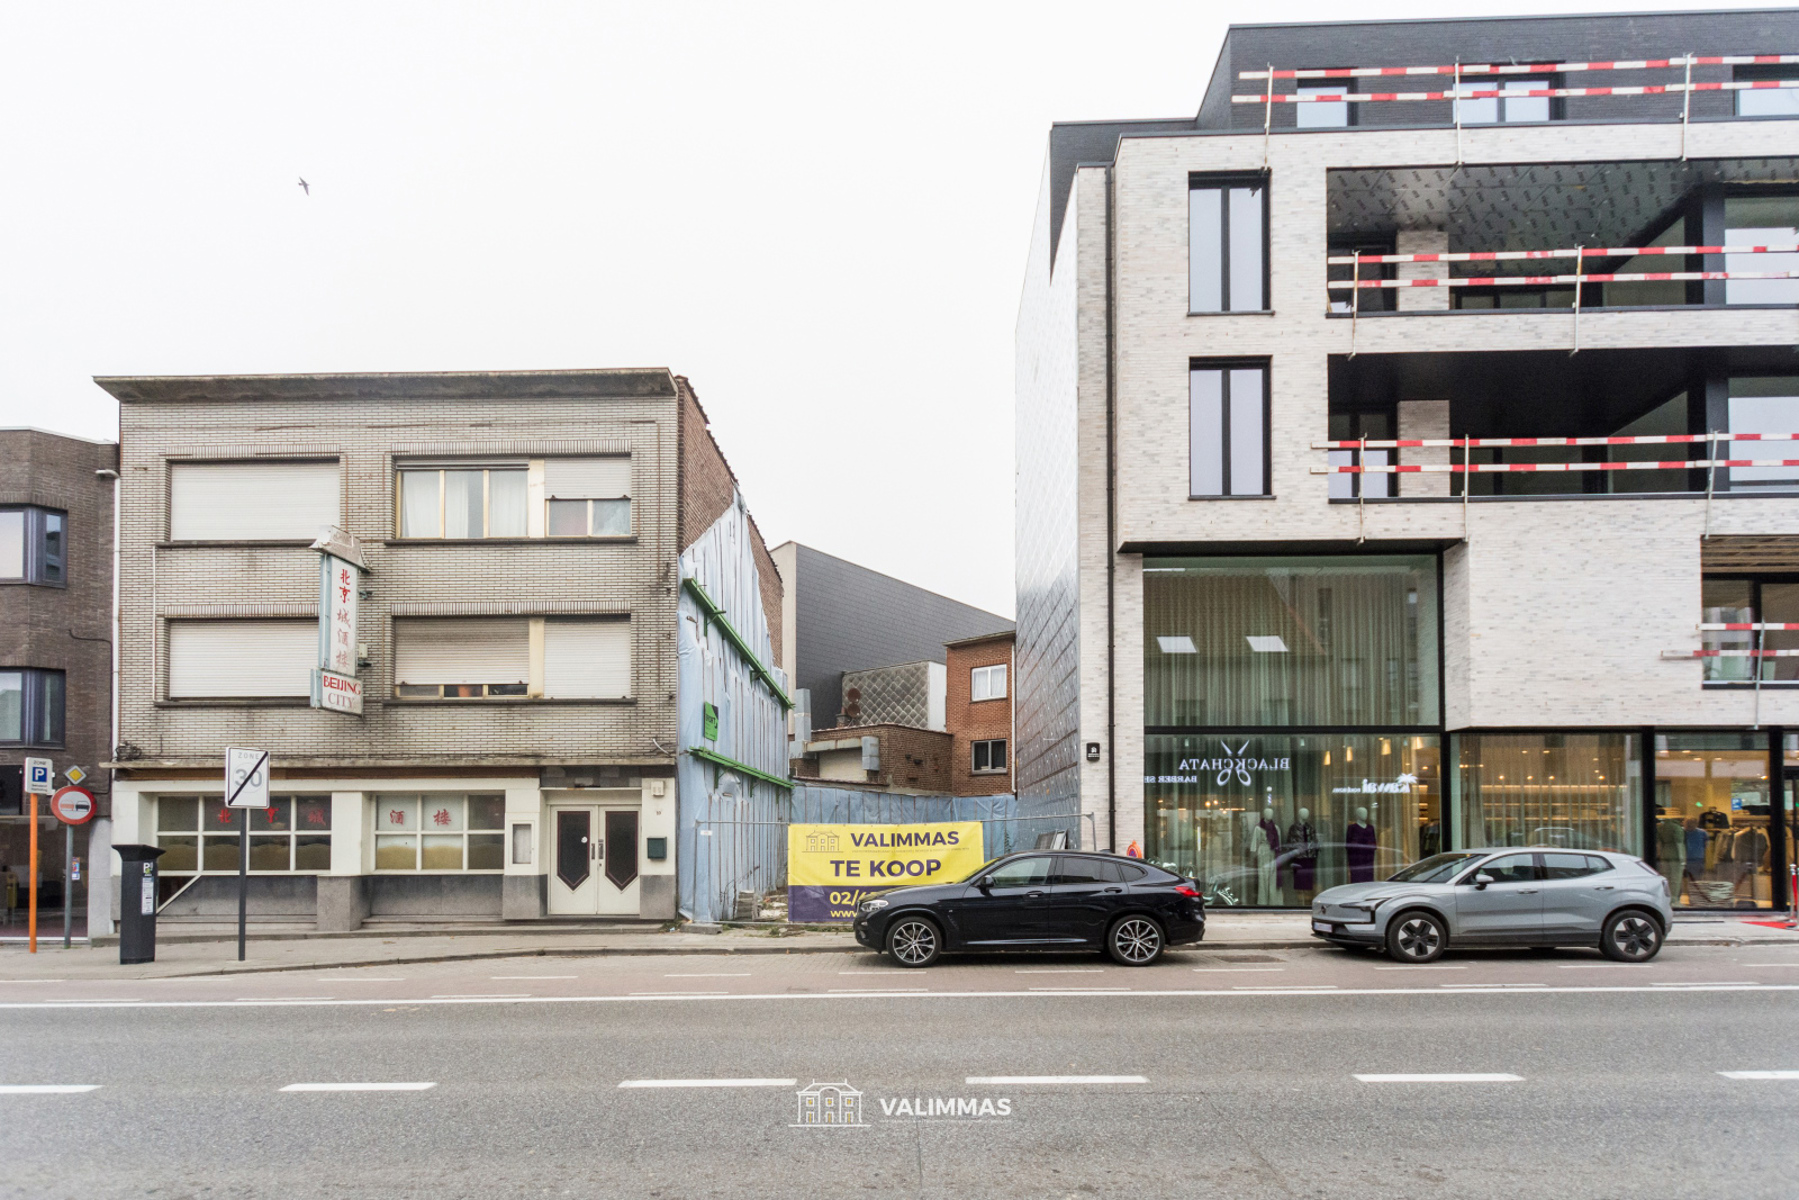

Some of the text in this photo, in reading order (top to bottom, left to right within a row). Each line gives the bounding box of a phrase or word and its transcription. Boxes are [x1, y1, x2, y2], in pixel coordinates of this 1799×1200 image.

[323, 675, 362, 695] BEIJING
[328, 692, 354, 708] CITY
[238, 752, 260, 760] ZONE
[35, 768, 45, 781] P
[235, 769, 263, 788] 30
[851, 831, 959, 848] VALIMMAS
[830, 859, 942, 877] TE KOOP
